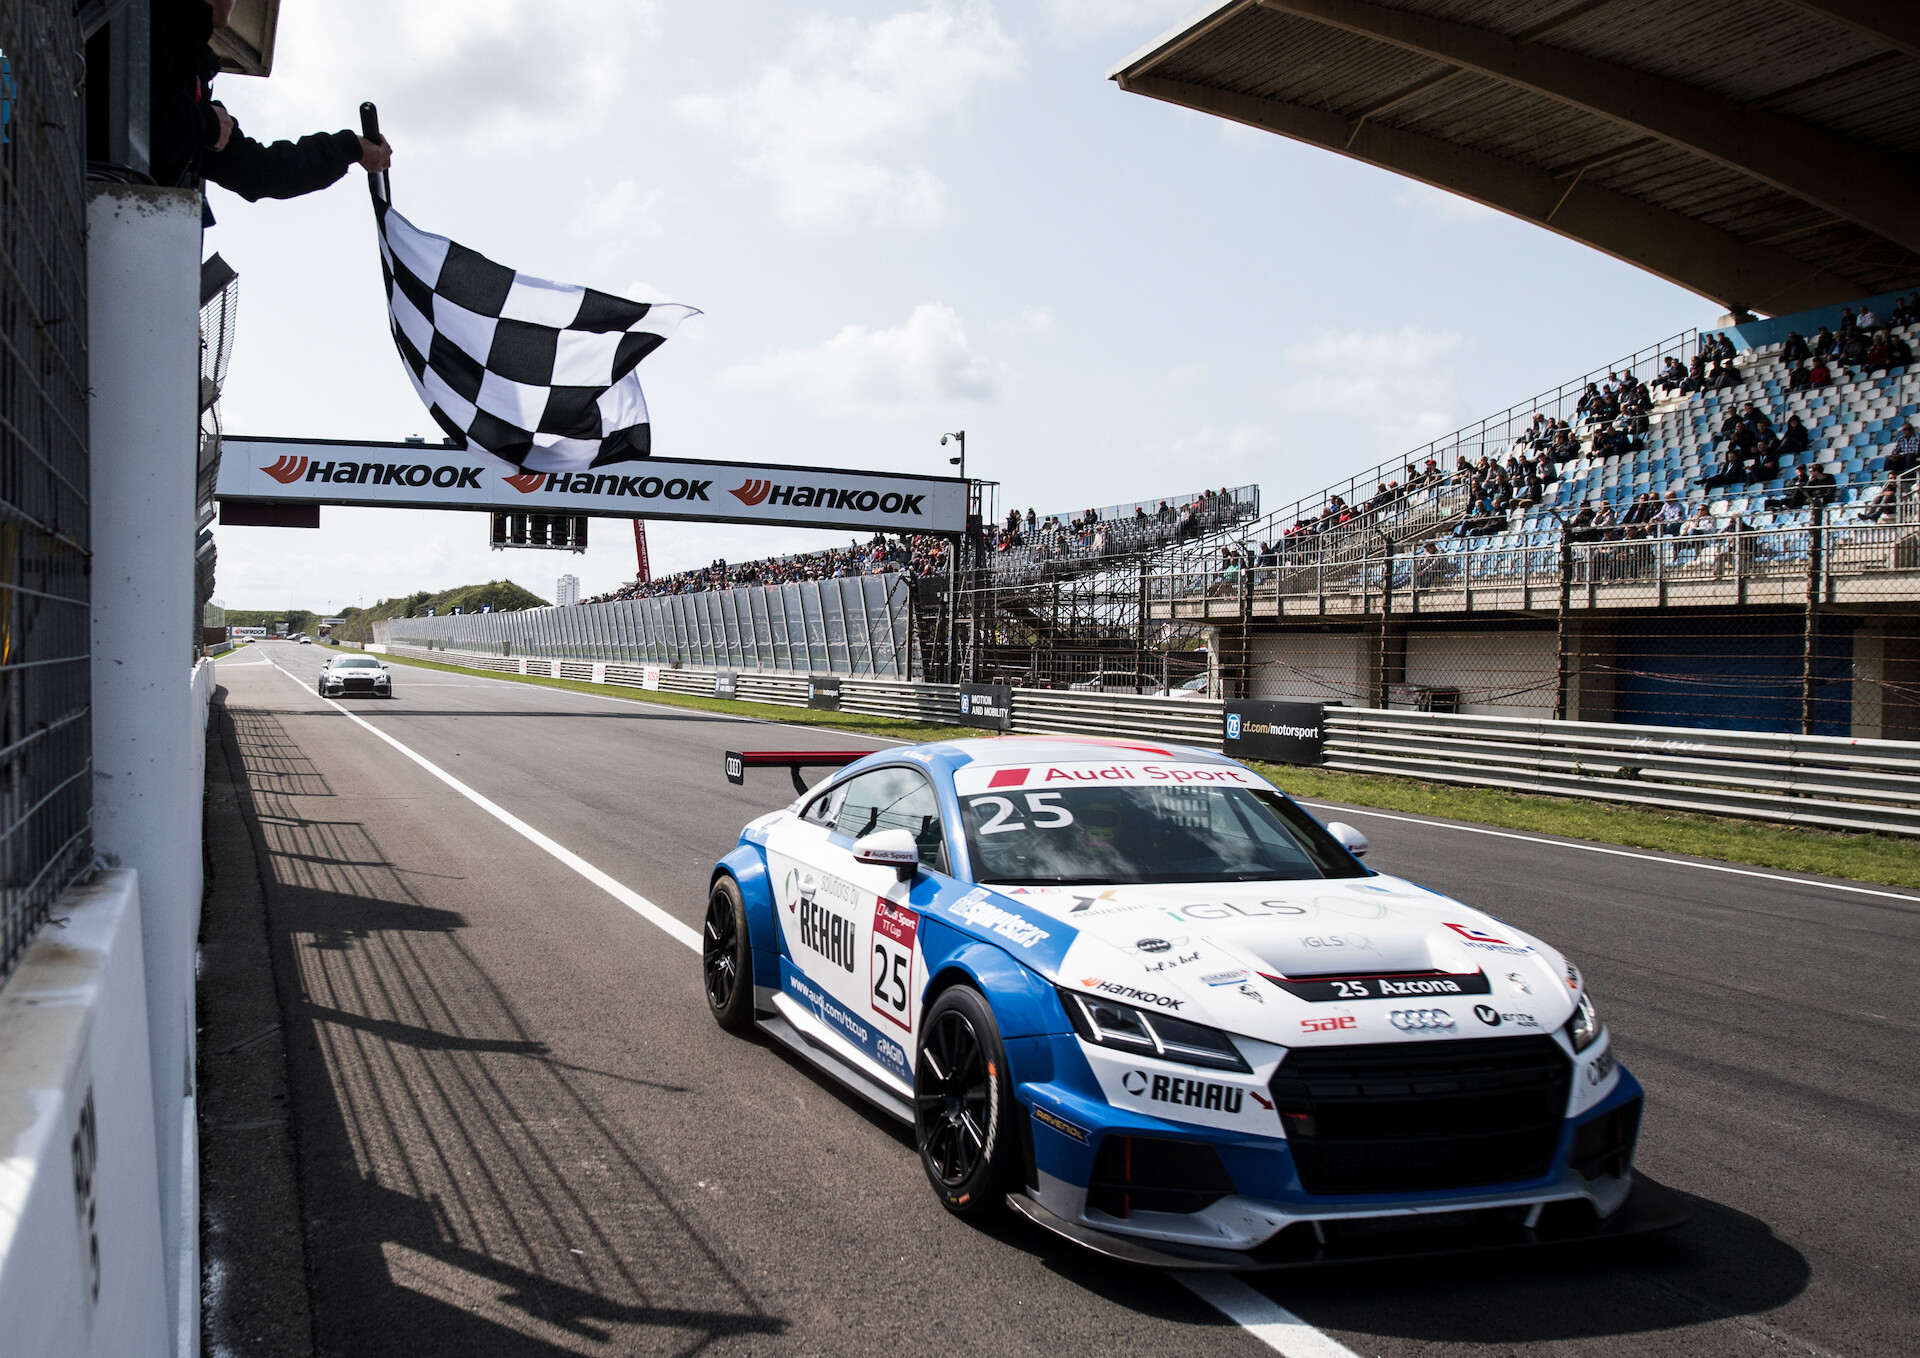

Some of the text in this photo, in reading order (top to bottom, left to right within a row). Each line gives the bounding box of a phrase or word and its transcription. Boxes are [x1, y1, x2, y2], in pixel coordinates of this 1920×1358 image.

[971, 694, 992, 705] MOTION
[971, 705, 1009, 718] AND MOBILITY
[1243, 721, 1318, 740] zf.com/motorsport
[1045, 766, 1248, 783] Audi Sport
[969, 792, 1075, 836] 25
[890, 852, 914, 860] Sport
[898, 912, 917, 930] Sport
[1158, 900, 1307, 922] iGLS
[800, 896, 856, 974] REHAU
[882, 919, 902, 939] TT Cup
[1298, 935, 1344, 949] iGLS
[874, 944, 907, 1012] 25
[1331, 978, 1462, 998] 25 Azcona
[790, 975, 869, 1043] www.audi.com/ttcup
[1300, 1016, 1358, 1033] sae
[1150, 1074, 1244, 1114] REHAU
[1036, 1107, 1084, 1140] RAVENOL
